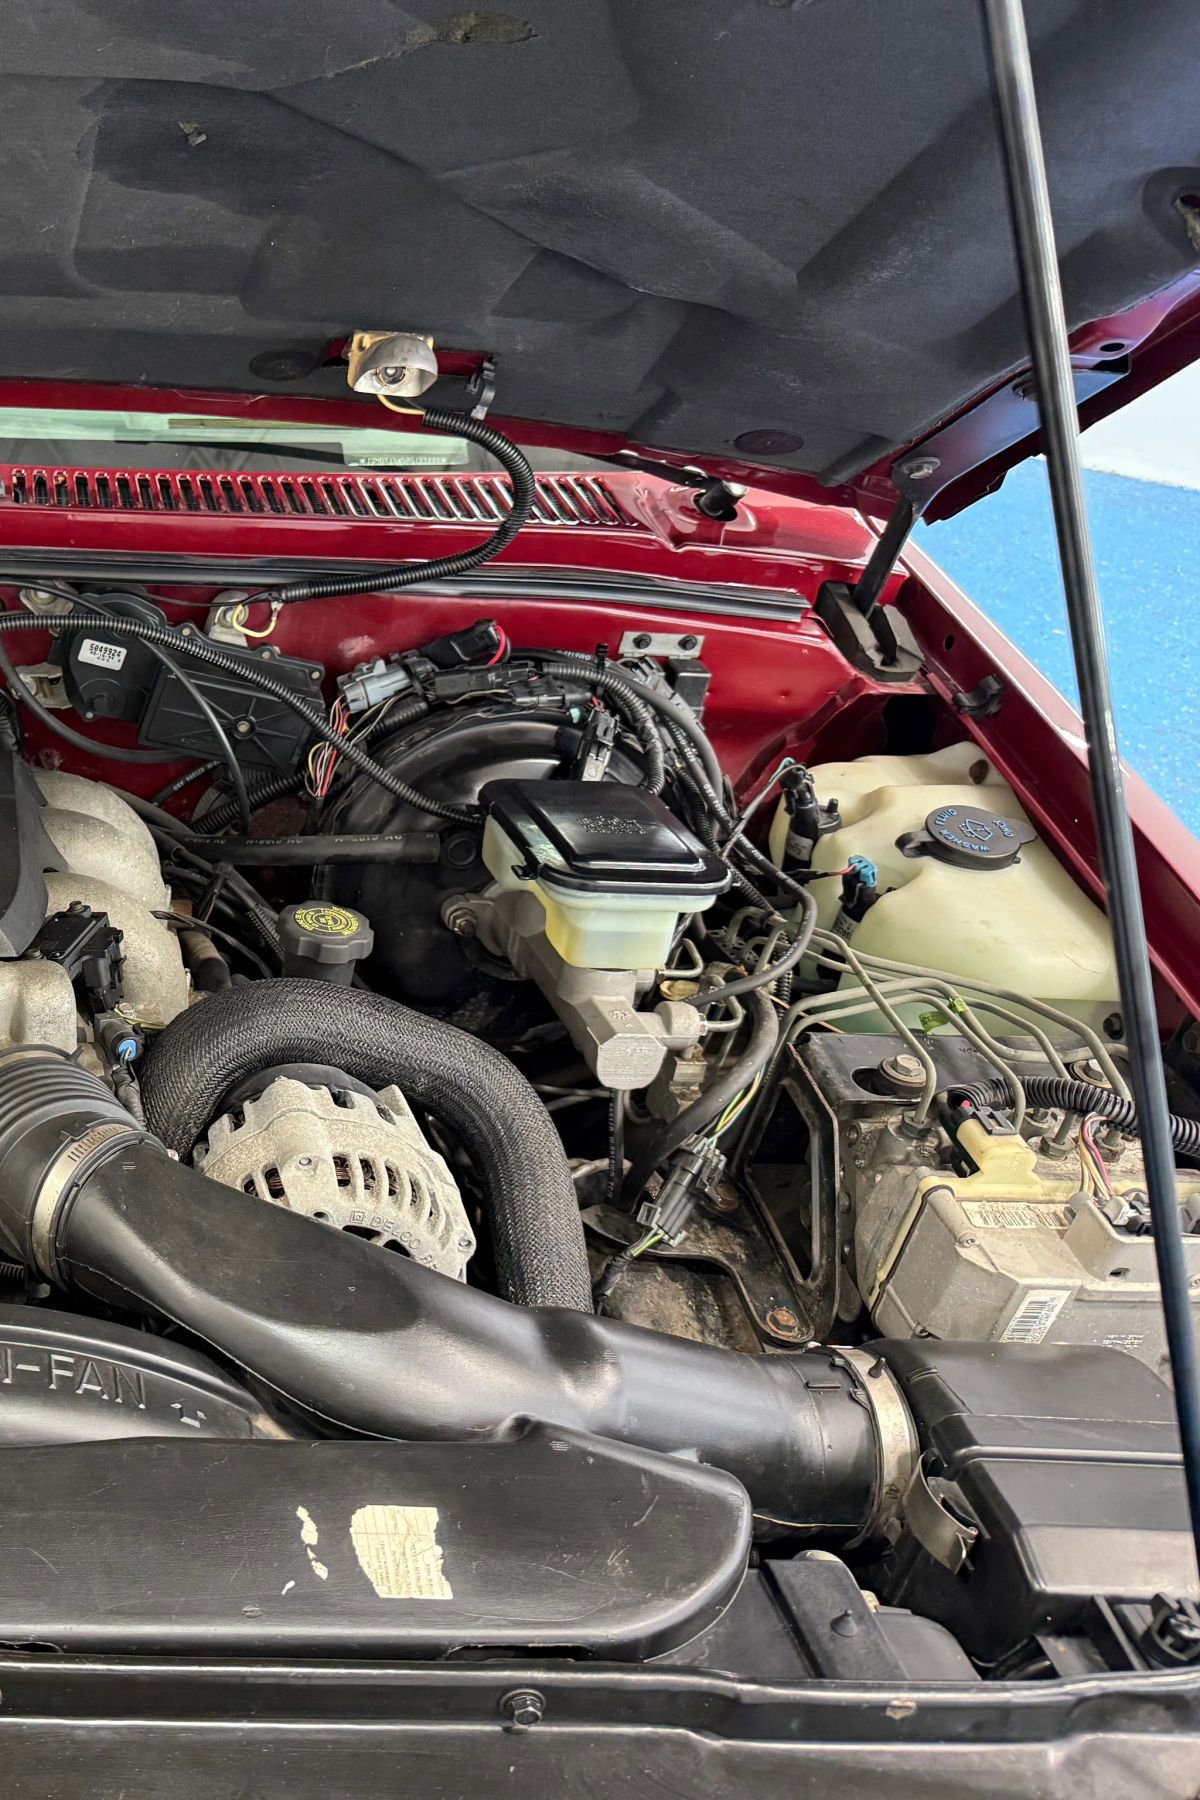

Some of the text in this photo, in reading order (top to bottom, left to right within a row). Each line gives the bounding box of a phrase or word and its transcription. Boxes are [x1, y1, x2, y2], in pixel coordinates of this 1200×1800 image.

[935, 808, 1014, 852] WASHER FLUID ONLY
